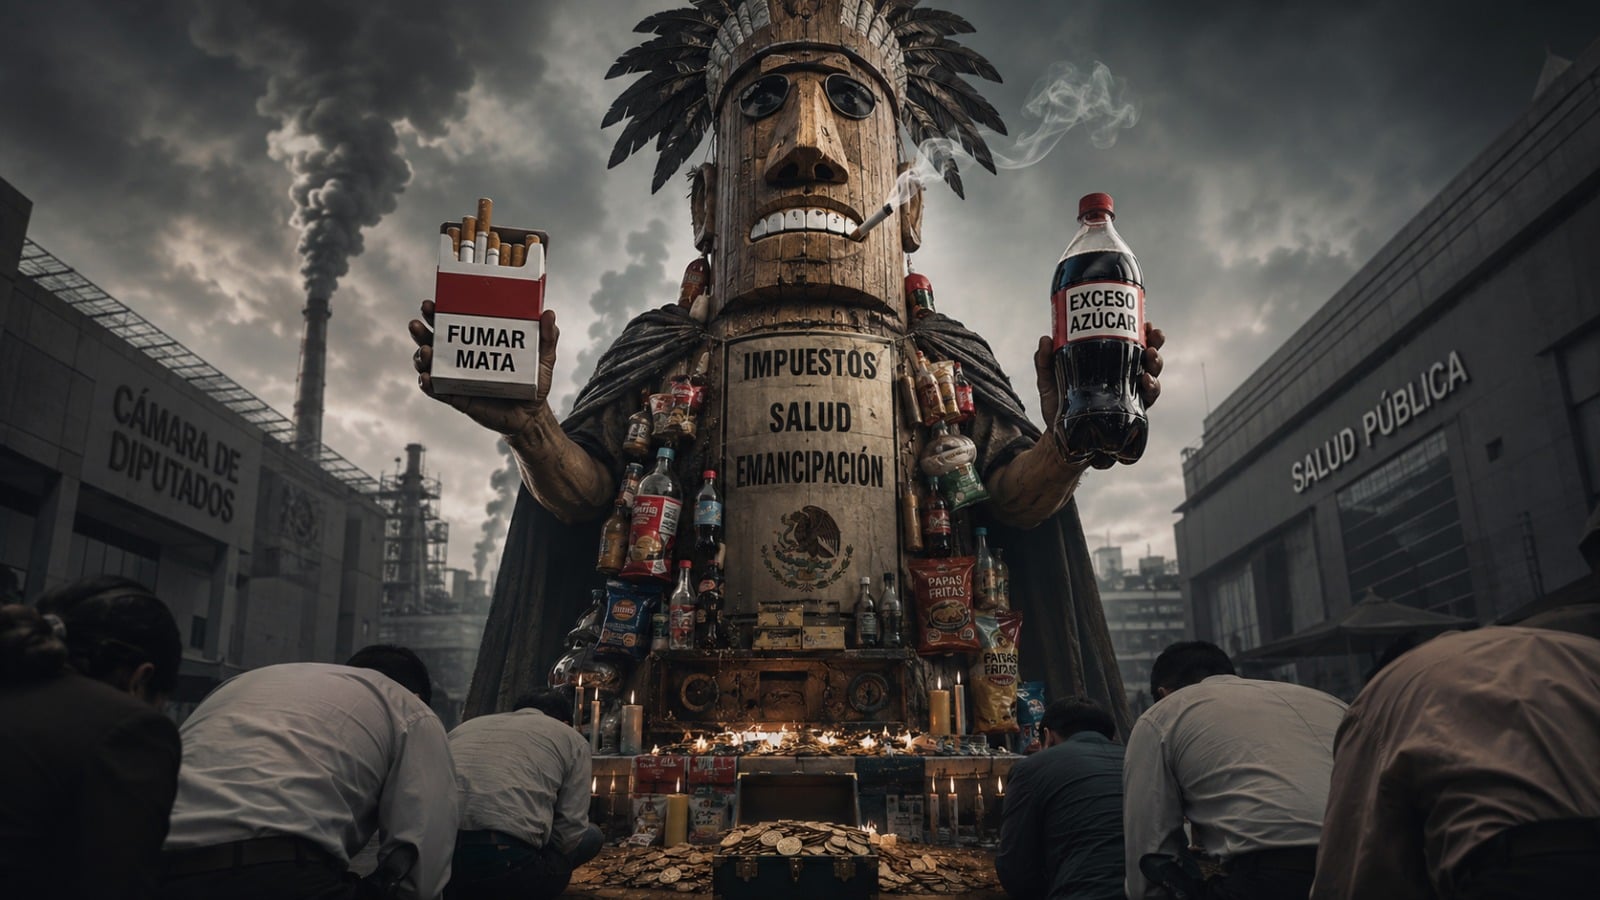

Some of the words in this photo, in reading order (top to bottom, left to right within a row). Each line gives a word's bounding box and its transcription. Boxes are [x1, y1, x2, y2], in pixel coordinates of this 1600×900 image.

[1070, 290, 1135, 312] EXCESO
[1070, 308, 1137, 334] AZÚCAR
[447, 325, 525, 349] FUMAR
[456, 349, 515, 372] MATA
[743, 348, 877, 381] IMPUESTOS
[769, 401, 852, 433] SALUD
[1291, 427, 1356, 493] SALUD
[1362, 350, 1469, 447] PÚBLICA
[113, 385, 209, 469] CÁMARA
[214, 441, 241, 484] DE
[109, 430, 235, 523] DIPUTADOS
[736, 446, 884, 488] EMANCIPACIÓN
[928, 575, 963, 587] PAPAS
[929, 586, 965, 599] FRITAS
